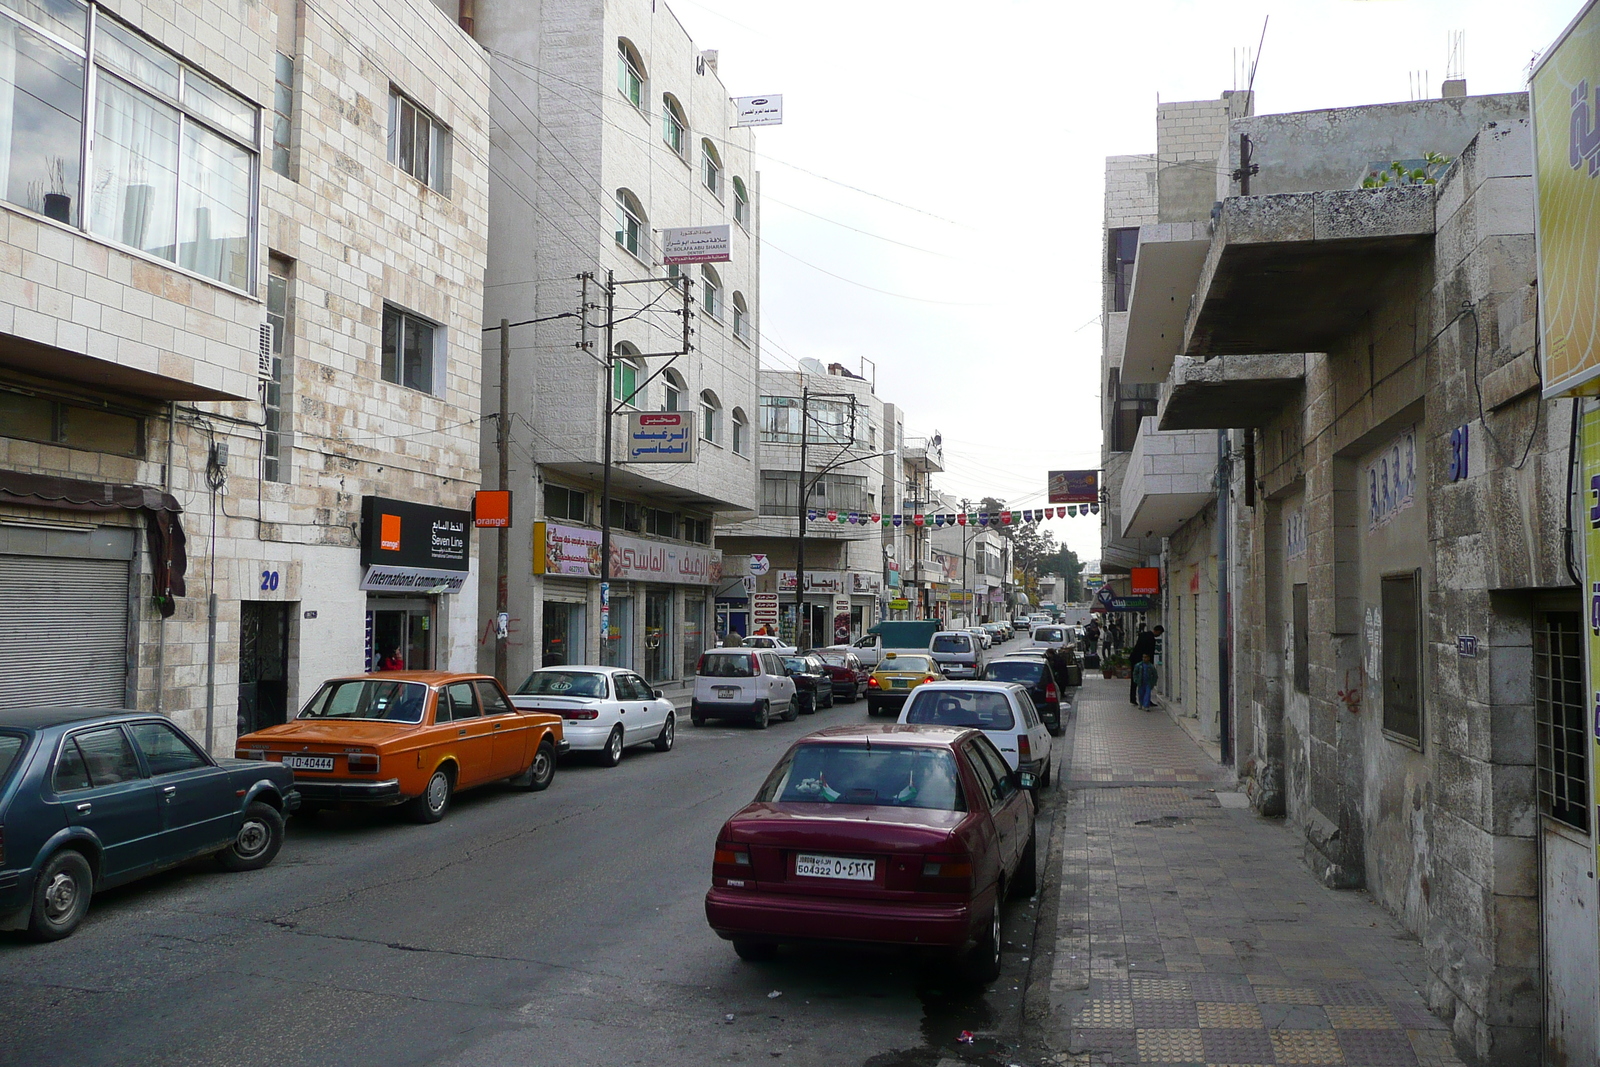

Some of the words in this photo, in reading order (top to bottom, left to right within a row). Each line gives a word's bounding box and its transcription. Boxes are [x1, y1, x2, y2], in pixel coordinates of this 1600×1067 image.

[645, 415, 677, 425] مخبز
[633, 426, 689, 442] الرغيف
[632, 441, 688, 459] الماسي
[1449, 424, 1469, 482] 31
[431, 519, 450, 534] السابع
[450, 521, 464, 532] الخط
[476, 518, 506, 527] orange
[381, 540, 399, 549] orange
[431, 534, 450, 547] Seven
[451, 536, 463, 548] Line
[619, 546, 666, 577] الماسي
[678, 550, 709, 582] الرغيف
[261, 570, 279, 591] 20
[367, 570, 417, 587] International
[798, 864, 831, 876] 504322
[834, 860, 874, 878] ٥٠٤٣٢٢
